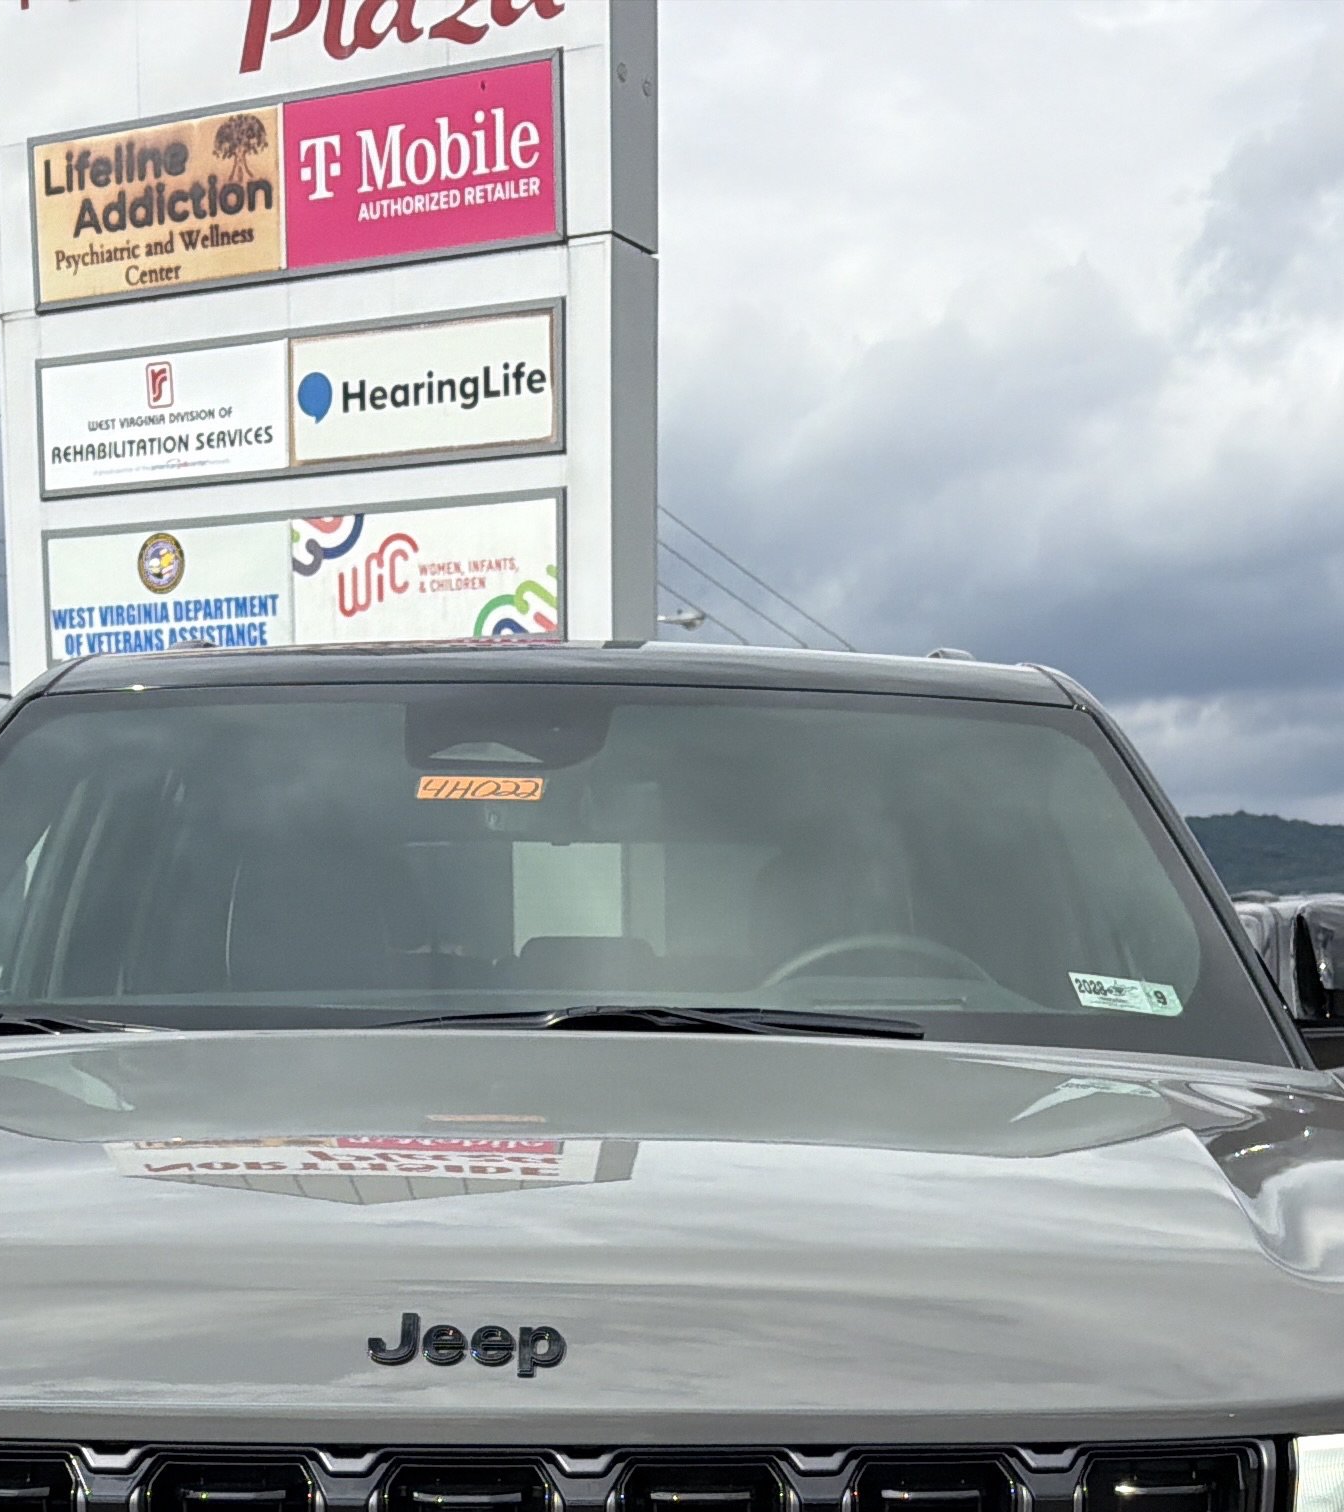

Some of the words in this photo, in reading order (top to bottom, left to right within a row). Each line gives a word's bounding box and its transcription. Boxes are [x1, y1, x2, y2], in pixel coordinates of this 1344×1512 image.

[44, 140, 189, 196] Lifeline
[356, 107, 540, 194] Mobile
[73, 174, 273, 238] Addiction
[357, 189, 460, 222] AUTHORIZED
[464, 176, 540, 206] RETAILER
[55, 239, 140, 276] Psychiatric
[145, 231, 174, 256] and
[179, 224, 254, 251] Wellness
[125, 264, 182, 286] Center
[342, 361, 547, 413] HearingLife
[88, 418, 116, 432] WEST
[119, 414, 165, 429] VIRGINIA
[169, 409, 215, 424] DIVISION
[219, 406, 233, 418] OF
[52, 434, 189, 464] REHABILITATION
[195, 426, 273, 450] SERVICES
[418, 561, 465, 576] WOMEN,
[468, 557, 520, 573] INFANTS,
[430, 577, 486, 592] CHILDREN
[52, 607, 94, 630] WEST
[99, 601, 169, 626] VIRGINIA
[174, 594, 279, 622] DEPARTMENT
[65, 634, 84, 656] OF
[86, 628, 164, 655] VETERANS
[168, 622, 267, 648] ASSISTANCE
[367, 1312, 567, 1379] Jeep
